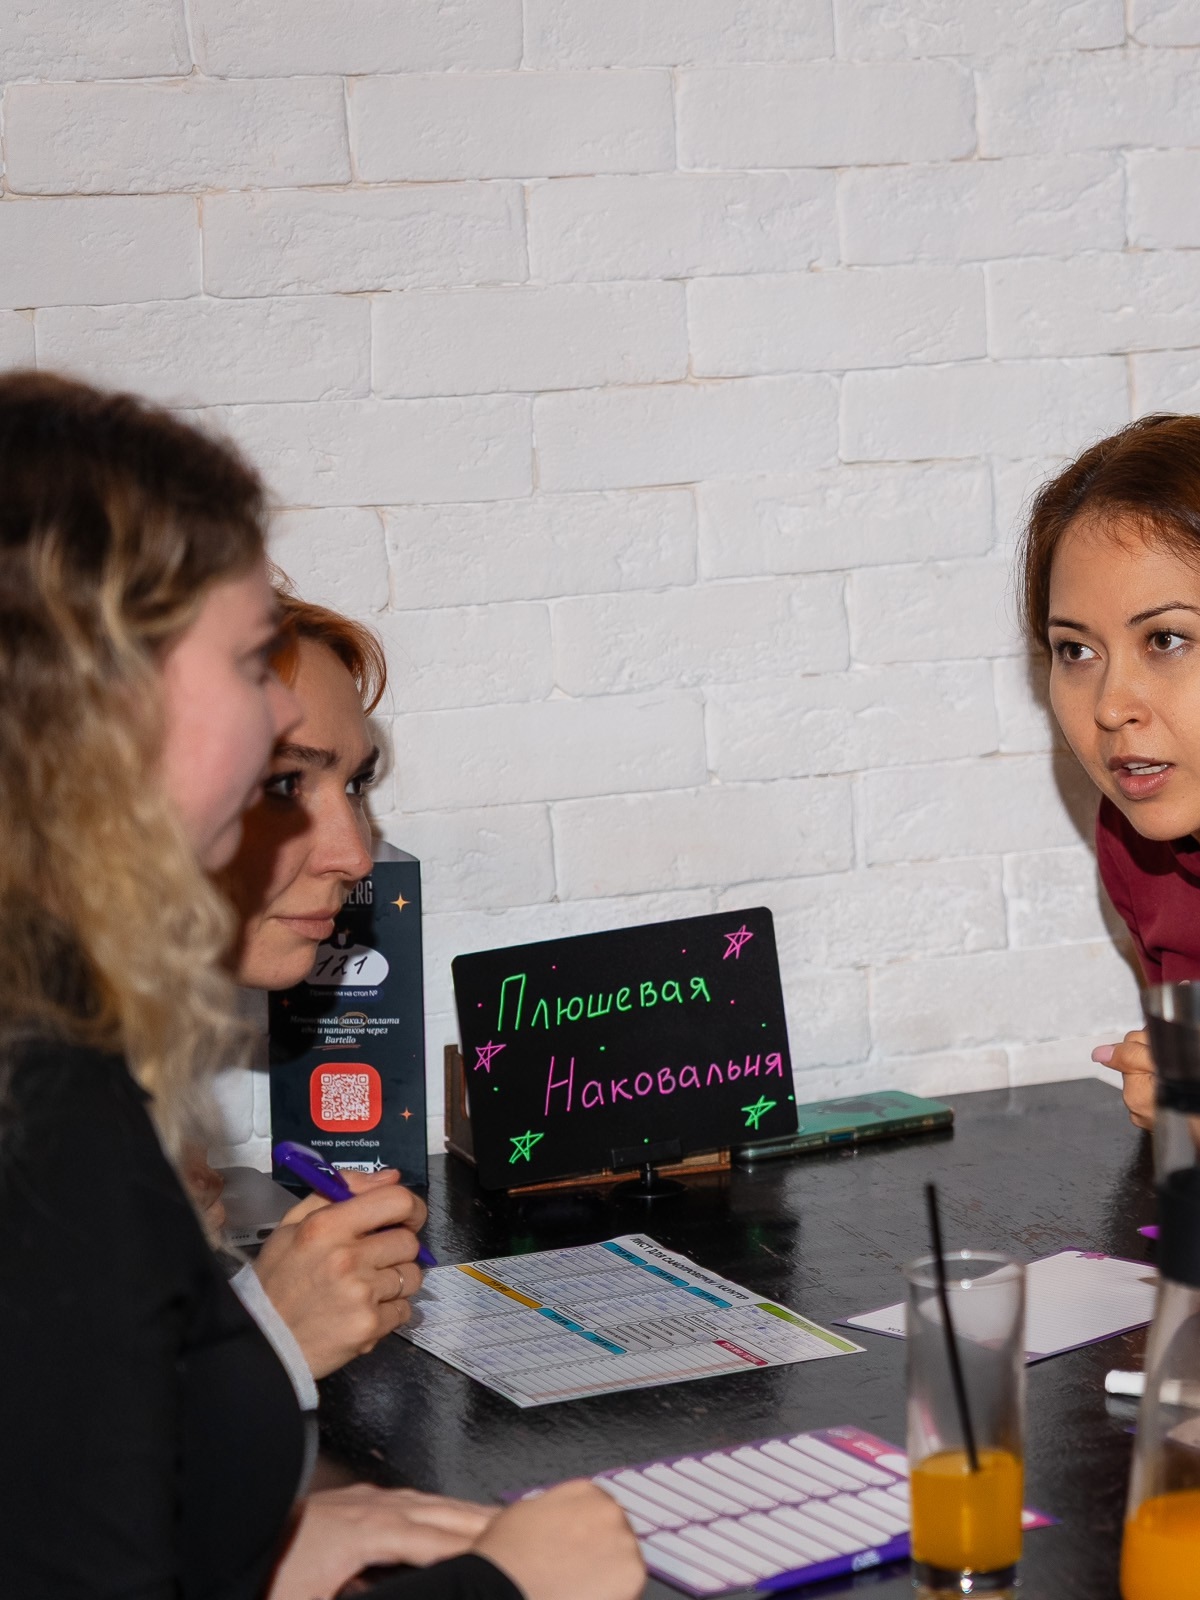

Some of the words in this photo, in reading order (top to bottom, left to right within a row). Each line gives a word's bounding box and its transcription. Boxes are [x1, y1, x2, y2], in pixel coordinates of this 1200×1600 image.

[315, 954, 368, 978] 121
[497, 973, 711, 1032] Плюшевая
[367, 1017, 400, 1025] оплата
[323, 1027, 365, 1035] напитков
[366, 1027, 389, 1036] через
[324, 1035, 357, 1044] Bartello
[544, 1052, 783, 1117] Наковальня
[335, 1138, 380, 1148] рестобара
